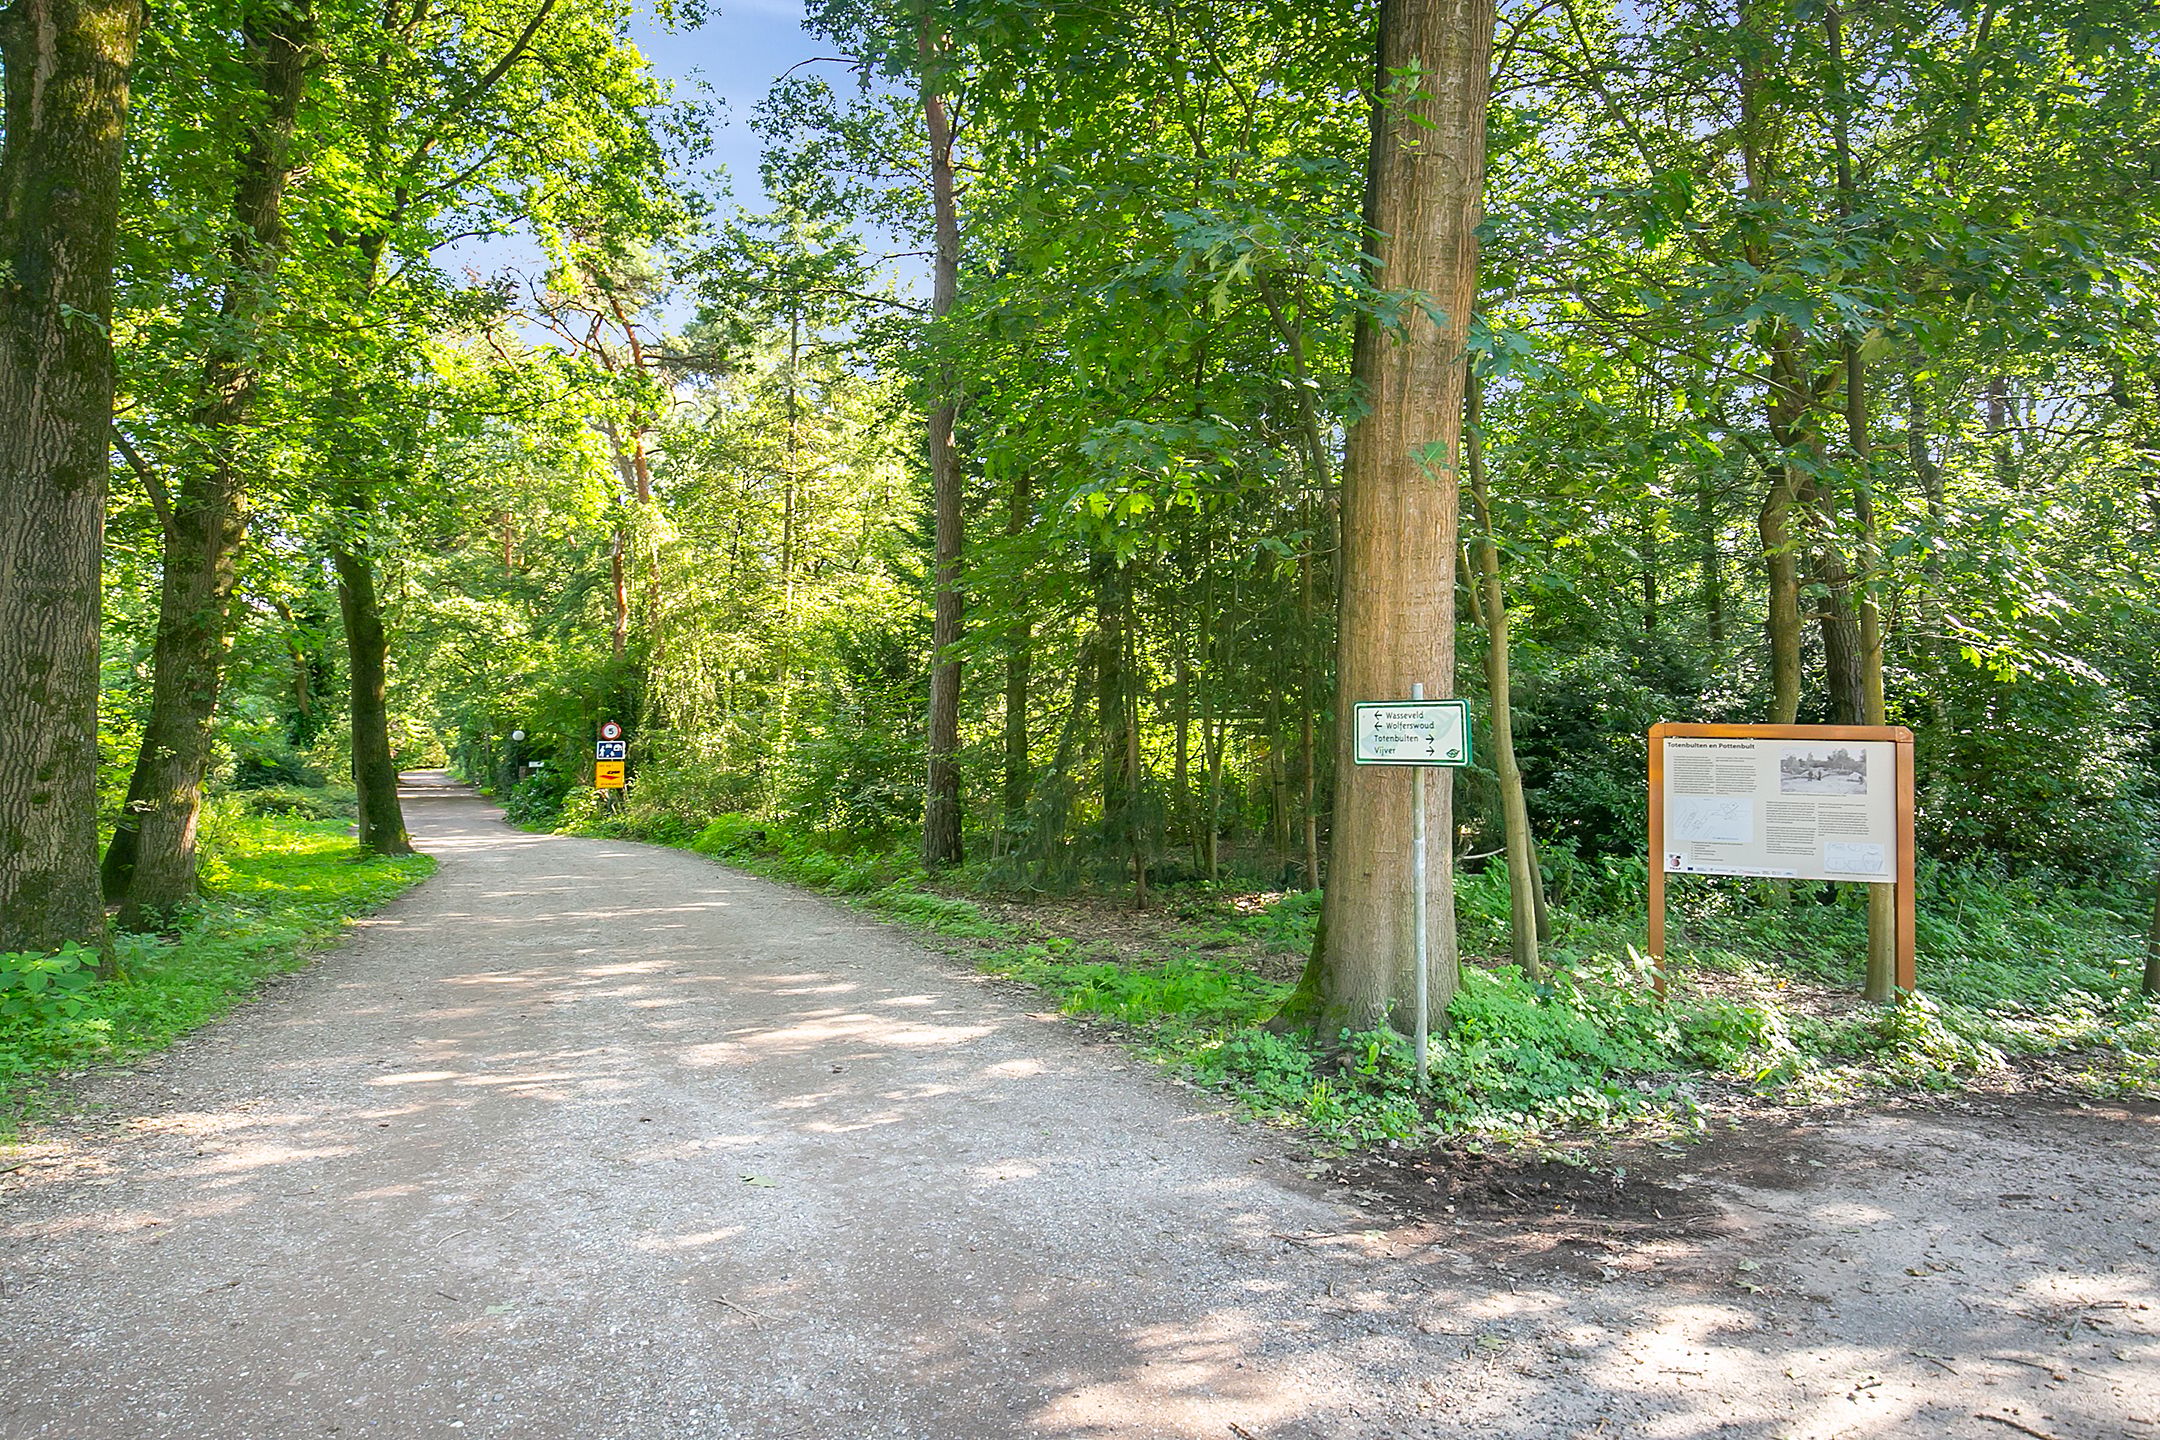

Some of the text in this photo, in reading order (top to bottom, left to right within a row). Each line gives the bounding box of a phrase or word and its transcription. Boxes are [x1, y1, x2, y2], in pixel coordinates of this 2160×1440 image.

[1386, 711, 1424, 719] Wasseveld
[1385, 721, 1435, 731] Wolferswoud
[1374, 734, 1419, 742] Totenbulten
[1374, 746, 1396, 756] Vijver
